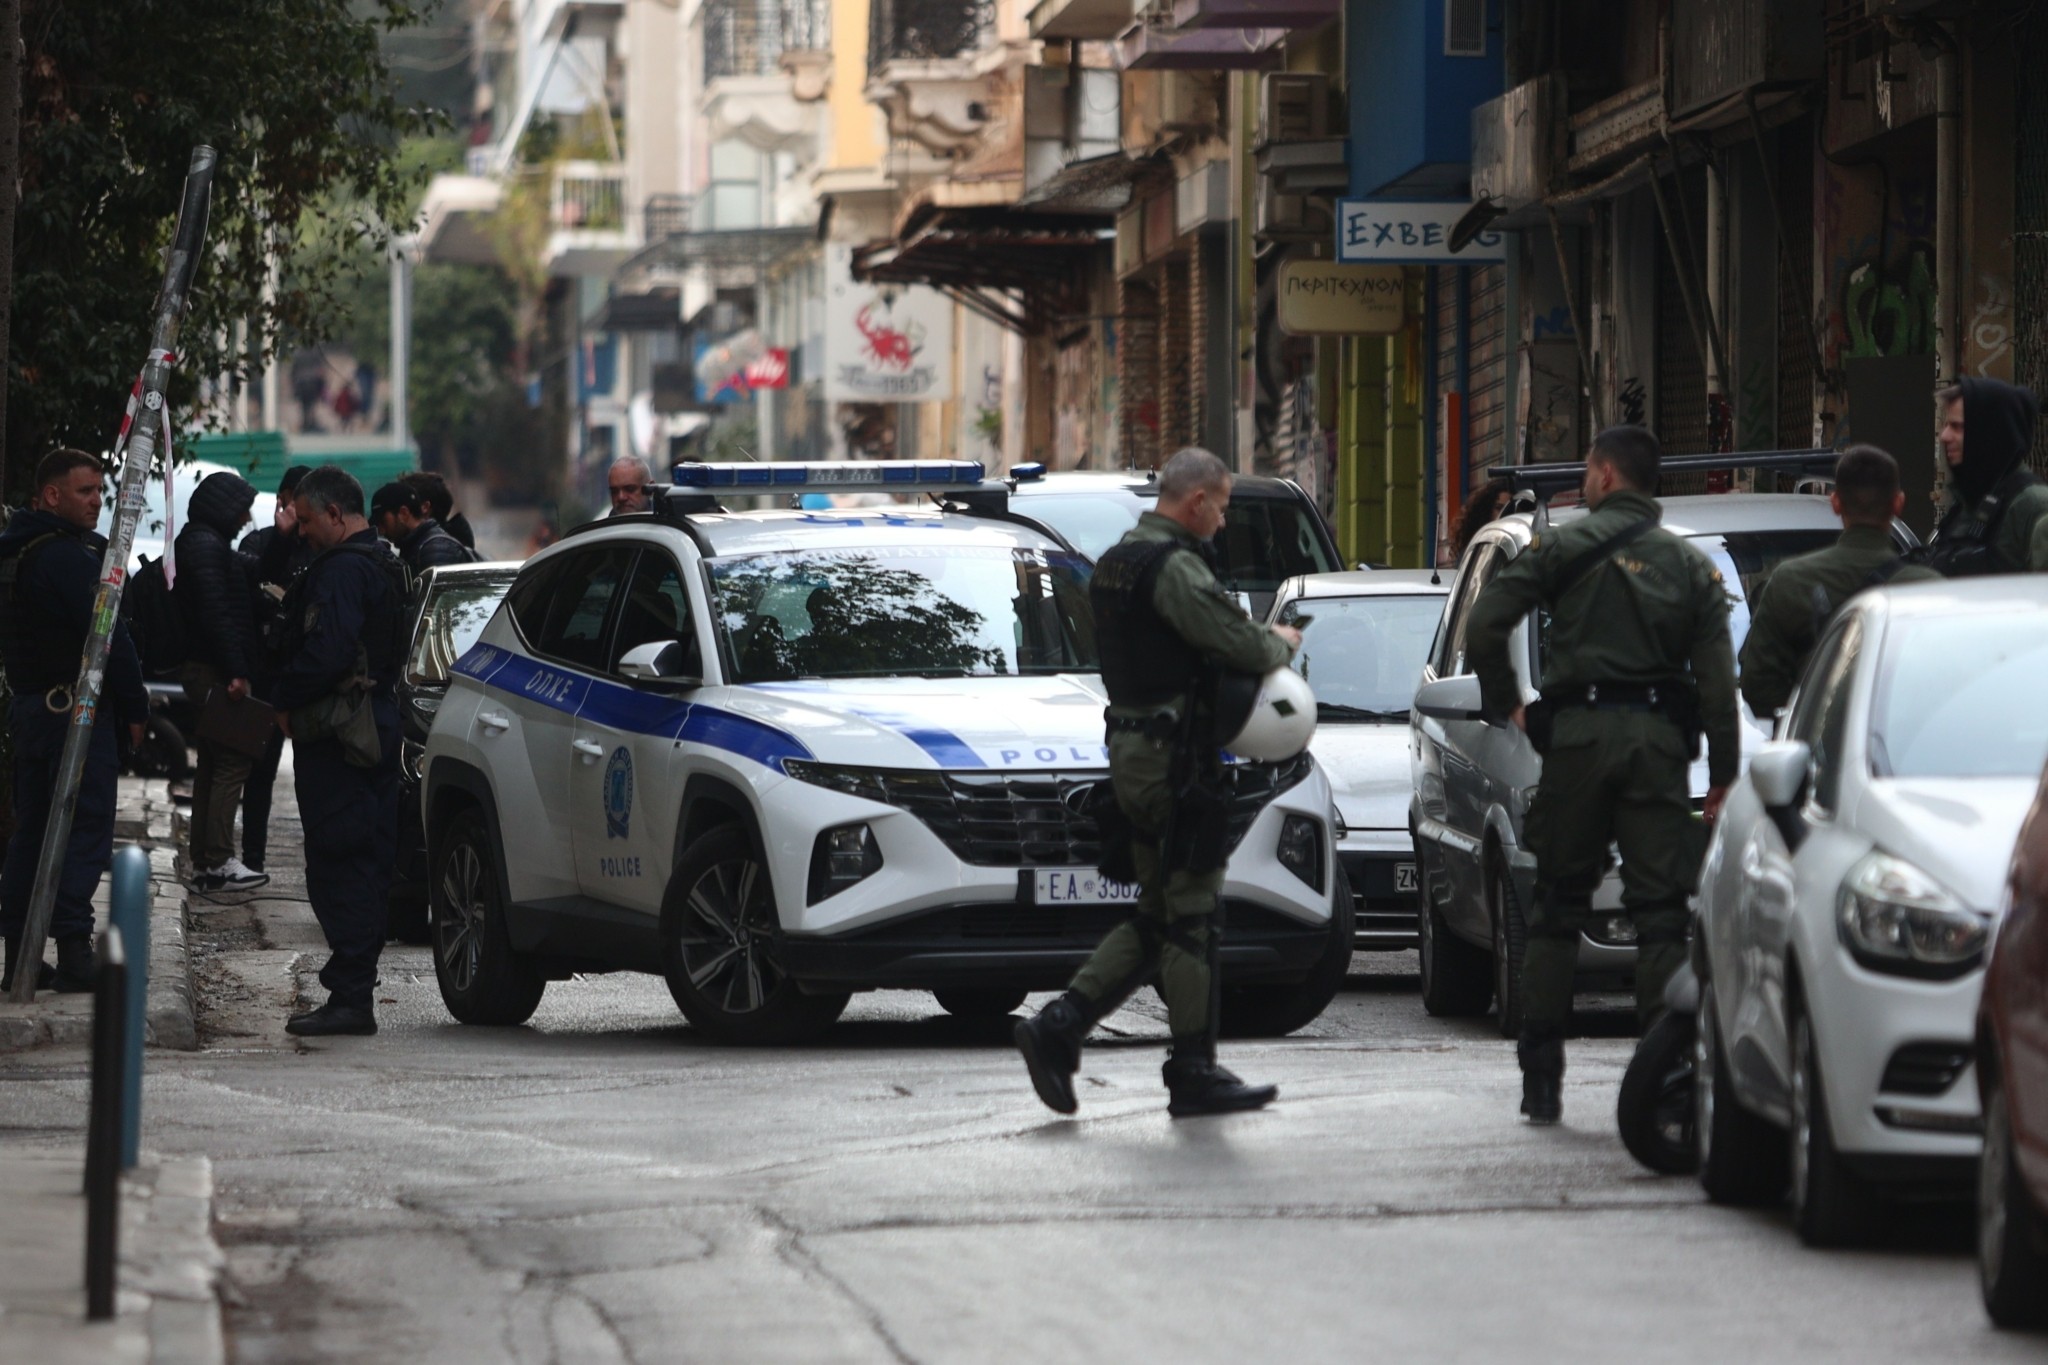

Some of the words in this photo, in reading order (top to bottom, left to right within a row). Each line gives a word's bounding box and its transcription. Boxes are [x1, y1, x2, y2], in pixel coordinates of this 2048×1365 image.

[1347, 212, 1501, 248] EXBEG
[525, 670, 574, 703] ΟΠΚΕ
[1001, 747, 1109, 765] POLI
[600, 856, 641, 878] POLICE
